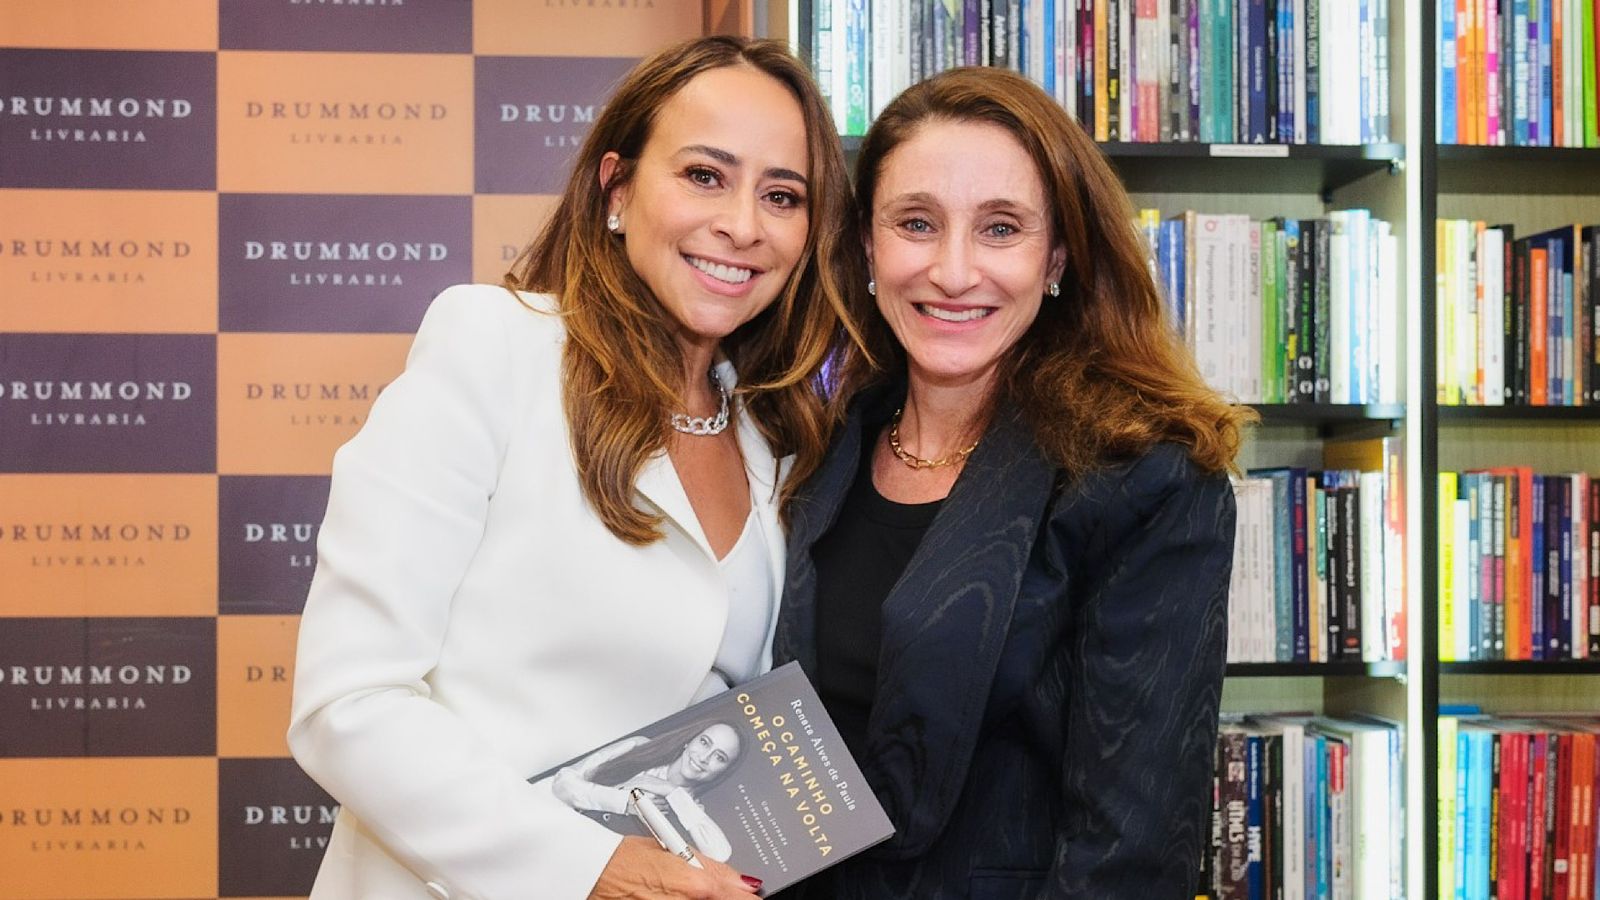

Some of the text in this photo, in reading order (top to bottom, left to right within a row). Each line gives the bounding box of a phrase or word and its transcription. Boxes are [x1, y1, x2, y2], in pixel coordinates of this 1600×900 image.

[0, 96, 192, 117] RUMMOND
[246, 101, 448, 120] DRUMMOND
[500, 103, 595, 123] DRUM
[30, 128, 147, 142] LIVRARIA
[290, 133, 403, 145] LIVRARIA
[0, 239, 191, 258] RUMMOND
[245, 241, 449, 261] DRUMMOND
[31, 271, 145, 284] LIVRARIA
[290, 273, 403, 286] LIVRARIA
[0, 380, 192, 400] RUMMOND
[246, 383, 369, 401] DRUMM
[31, 412, 147, 426] LIVRARIA
[291, 414, 359, 425] LIVRA
[0, 523, 191, 542] RUMMOND
[31, 555, 146, 567] LIVRARIA
[0, 665, 192, 685] RUMMOND
[31, 697, 147, 710] LIVRARIA
[790, 698, 856, 811] Renata Alves de Paula
[772, 715, 833, 815] O CAMINHO
[737, 693, 833, 857] COMEÇA NA VOLTA
[738, 784, 745, 793] de
[0, 807, 191, 826] RUMMOND
[245, 805, 339, 825] DRUM
[761, 800, 788, 846] Uma jornada
[31, 840, 146, 852] LIVRARIA
[738, 812, 769, 865] transformação
[1247, 826, 1261, 862] HYPE
